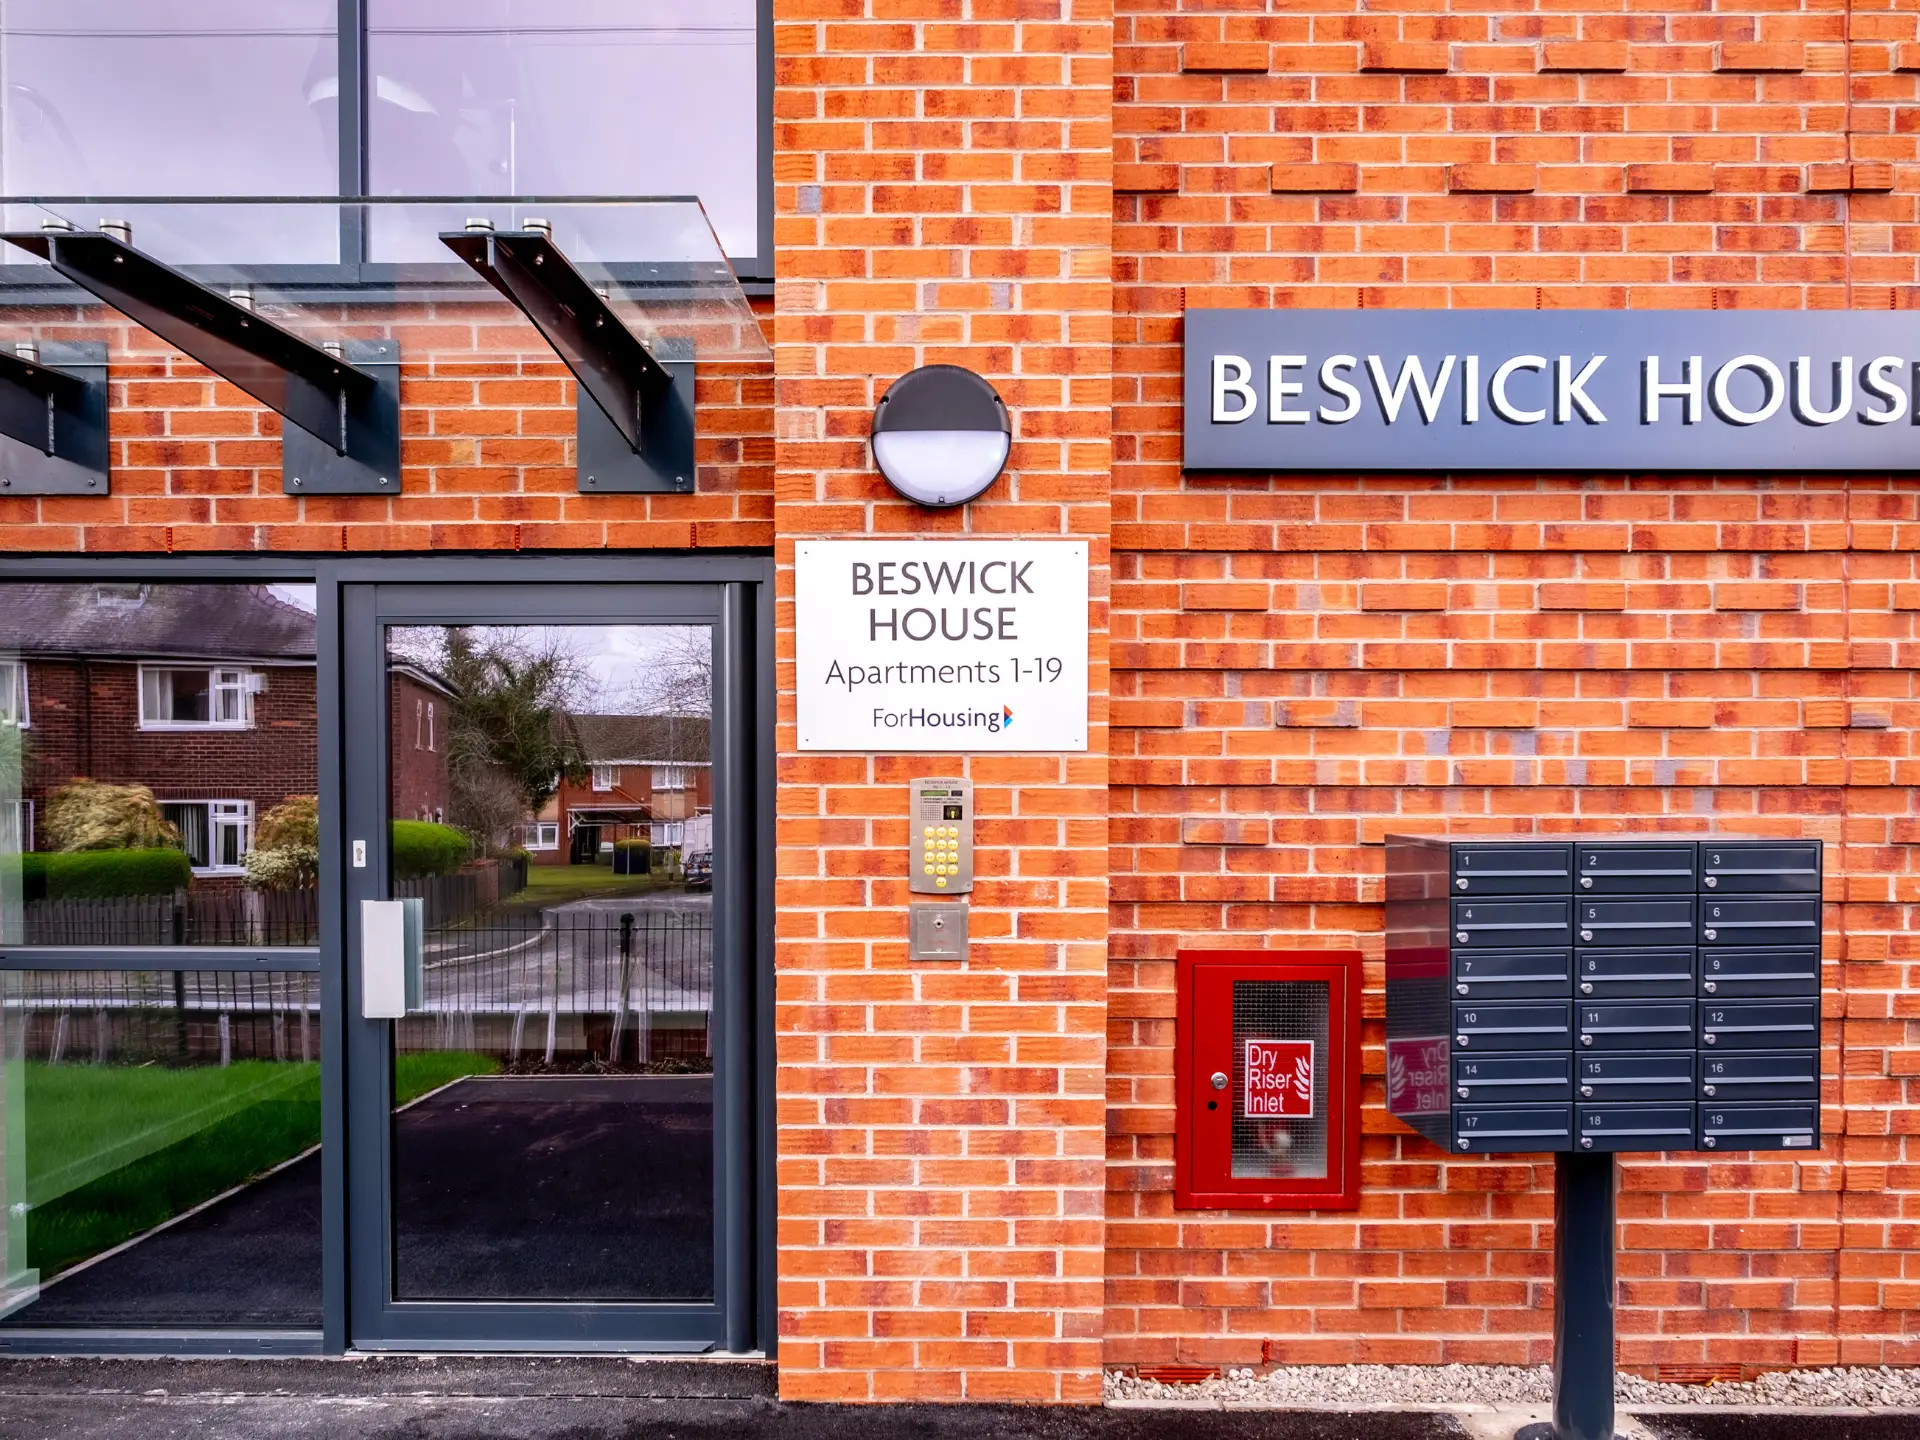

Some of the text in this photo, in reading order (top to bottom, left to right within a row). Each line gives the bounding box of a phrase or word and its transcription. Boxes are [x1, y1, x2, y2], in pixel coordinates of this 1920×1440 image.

[1211, 354, 1920, 426] BESWICK HOUS
[852, 560, 1035, 596] BESWICK
[869, 607, 1018, 642] HOUSE
[824, 656, 1063, 693] Apartments 1-19
[873, 707, 1001, 733] ForHousing
[1589, 855, 1597, 866] 2
[1713, 854, 1721, 865] 3
[1465, 909, 1473, 919] 4
[1588, 908, 1596, 919] 5
[1713, 906, 1721, 918] 6
[1464, 962, 1472, 972] 7
[1588, 960, 1596, 971] 8
[1712, 959, 1721, 970] 9
[1464, 1012, 1477, 1023] 10
[1588, 1012, 1599, 1023] 11
[1711, 1011, 1724, 1022] 12
[1249, 1045, 1278, 1071] Dry
[1465, 1065, 1478, 1075] 14
[1588, 1063, 1601, 1073] 15
[1711, 1062, 1724, 1073] 16
[1249, 1068, 1293, 1090] Riser
[1248, 1091, 1285, 1113] Inlet
[1466, 1117, 1478, 1127] 17
[1589, 1115, 1601, 1126] 18
[1711, 1114, 1724, 1125] 19
